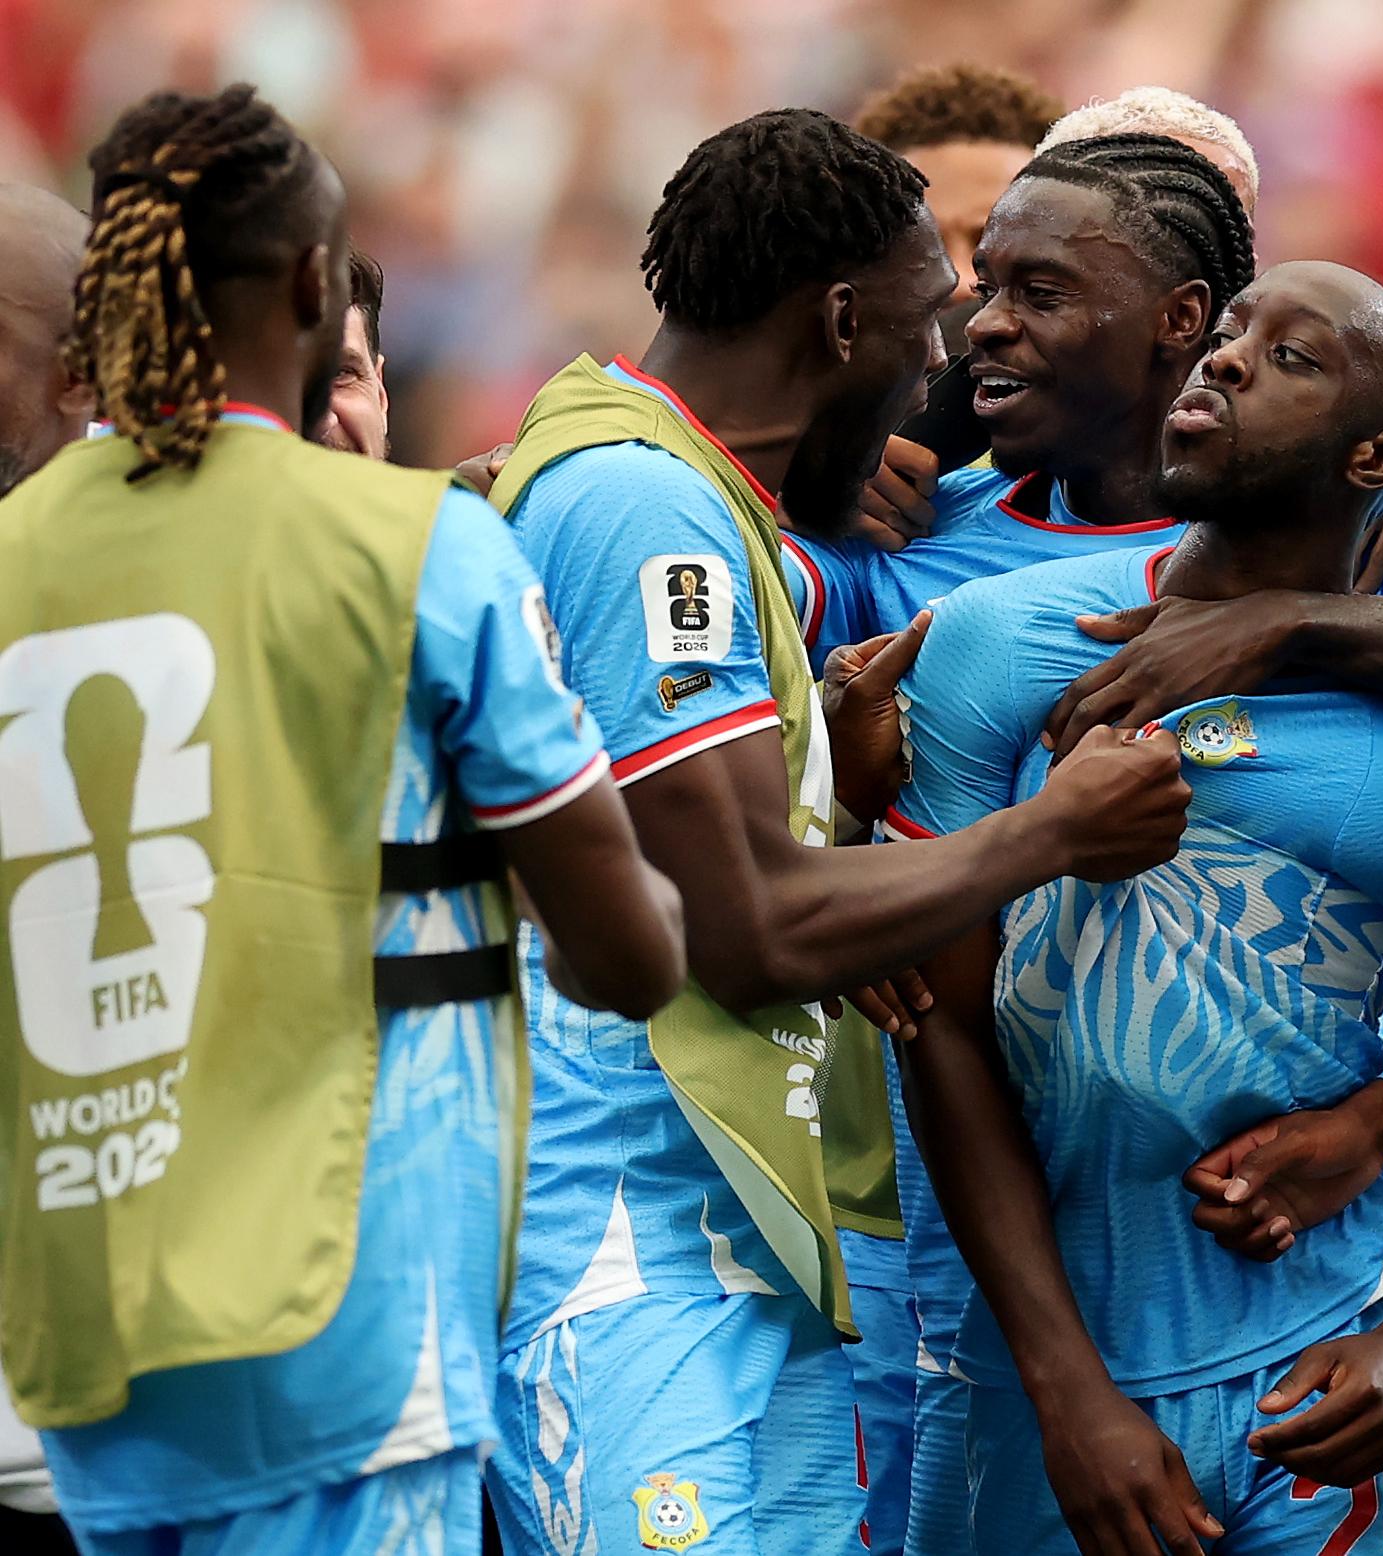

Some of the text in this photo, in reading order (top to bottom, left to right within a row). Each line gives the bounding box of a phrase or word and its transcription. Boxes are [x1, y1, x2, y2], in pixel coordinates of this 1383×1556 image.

[682, 616, 701, 626] FIFA
[673, 642, 708, 652] 2026
[675, 674, 707, 693] DEBUT
[1179, 719, 1205, 760] FECOFA
[91, 972, 169, 1030] FIFA
[30, 1077, 156, 1141] WORLD
[36, 1119, 181, 1212] 202
[652, 1528, 700, 1546] FECOFA
